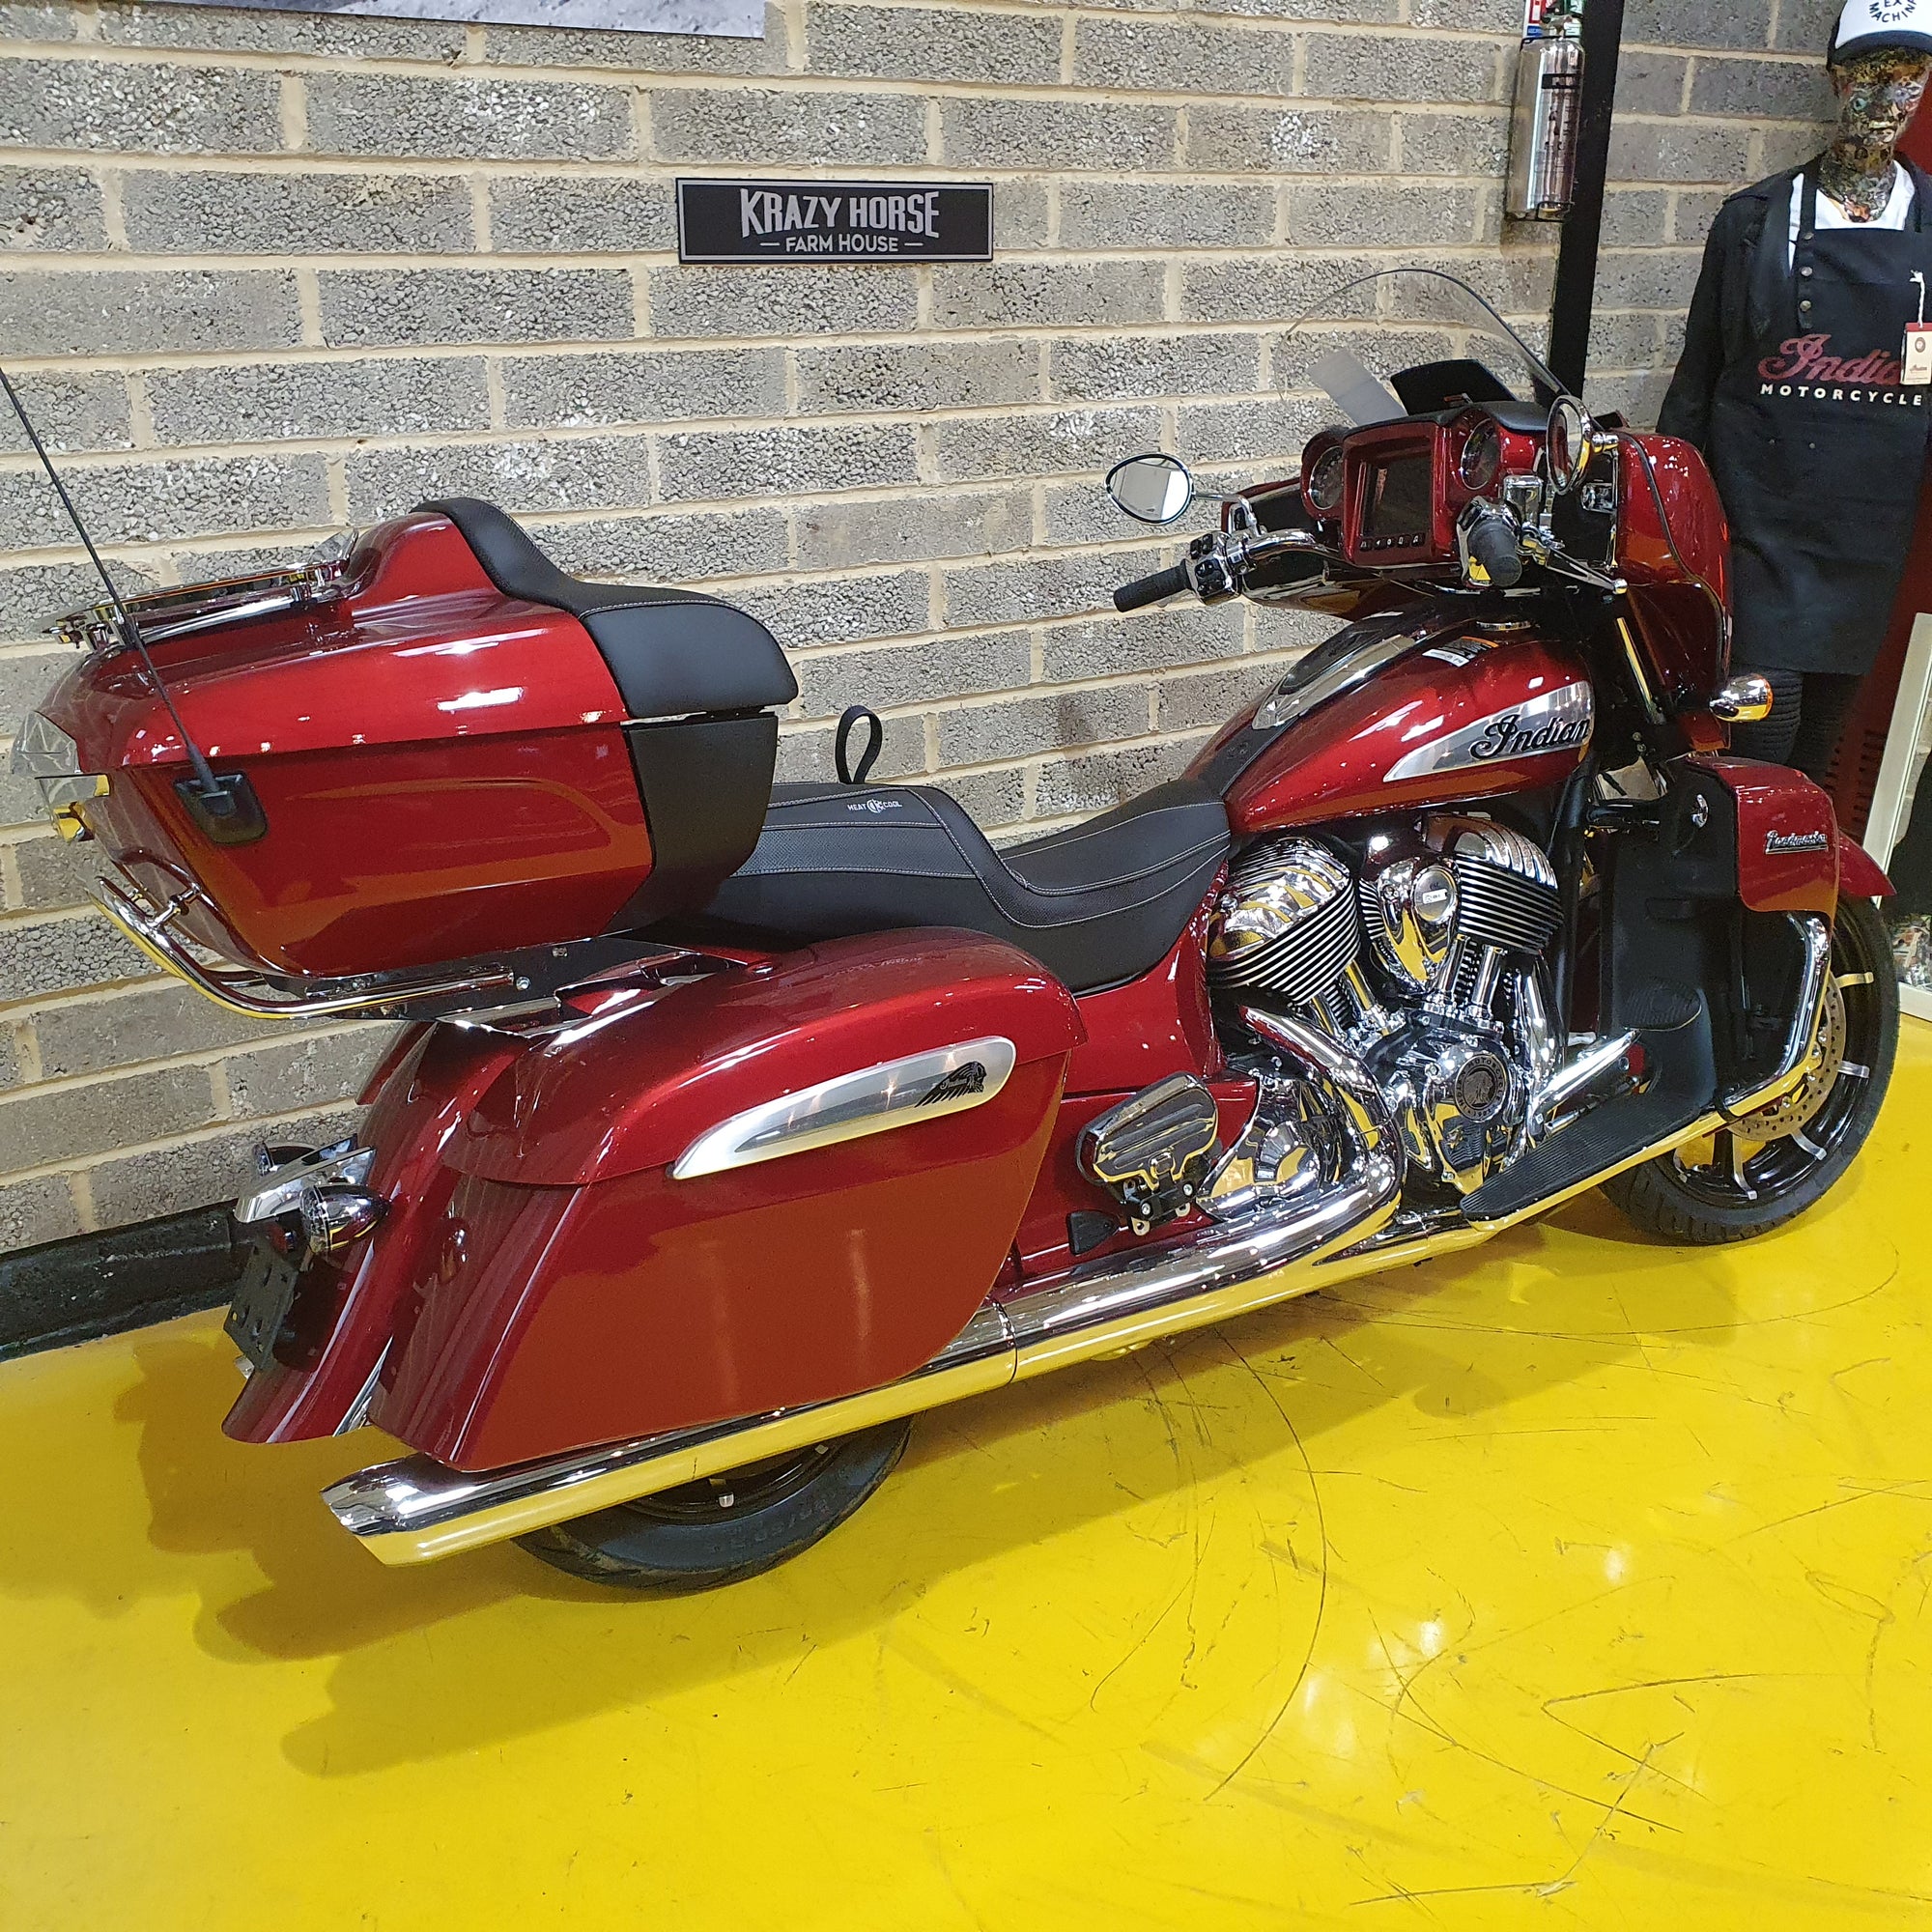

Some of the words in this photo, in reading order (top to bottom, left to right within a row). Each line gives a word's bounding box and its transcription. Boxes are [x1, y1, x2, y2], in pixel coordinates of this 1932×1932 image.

[740, 187, 842, 239] KRAZY
[848, 190, 940, 239] HORSE
[785, 236, 834, 252] FARM
[838, 234, 899, 252] HOUSE
[1757, 333, 1902, 385] India
[1759, 384, 1923, 407] MOTORCYCLE
[1468, 713, 1591, 760] Indian
[846, 803, 867, 811] HEAT
[882, 800, 903, 809] COOL
